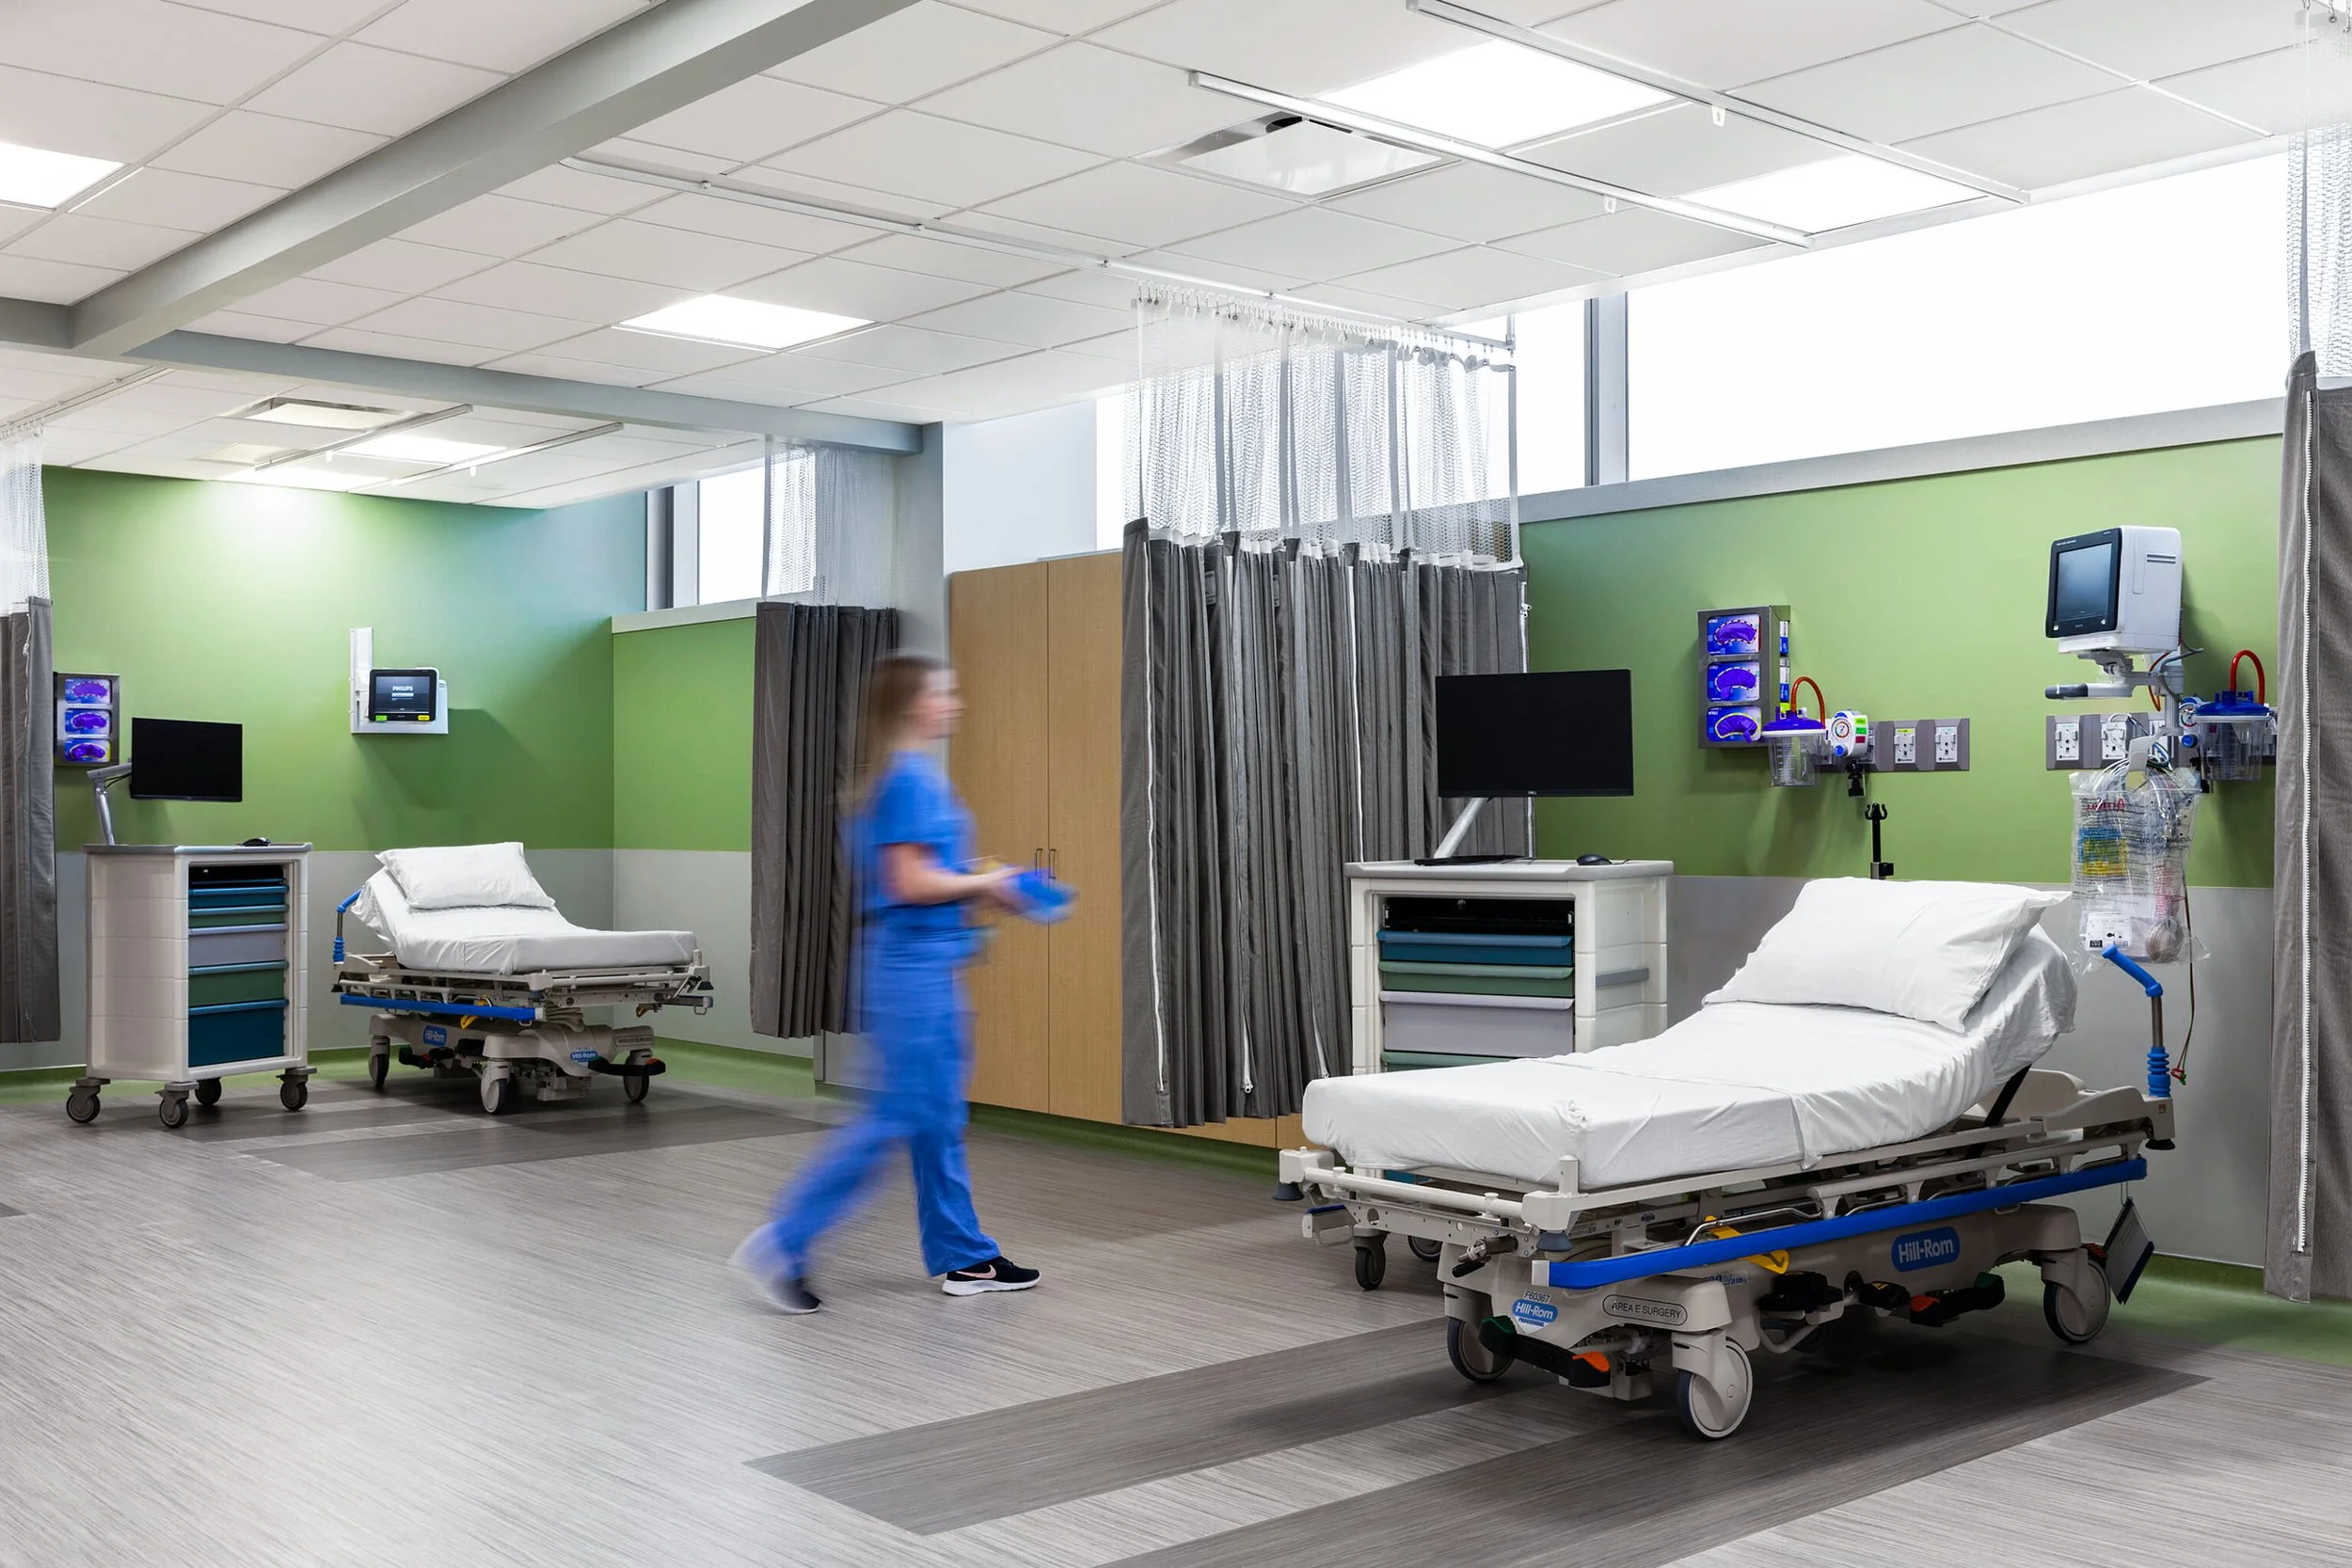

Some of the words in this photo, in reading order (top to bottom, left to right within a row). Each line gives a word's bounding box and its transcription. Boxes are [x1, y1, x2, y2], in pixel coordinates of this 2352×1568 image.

[1898, 1238, 1954, 1263] Hill-Rom
[1516, 1302, 1553, 1319] Hill-Rom
[1611, 1302, 1633, 1312] AREA
[1635, 1305, 1641, 1313] E
[1642, 1306, 1681, 1319] SURGERY
